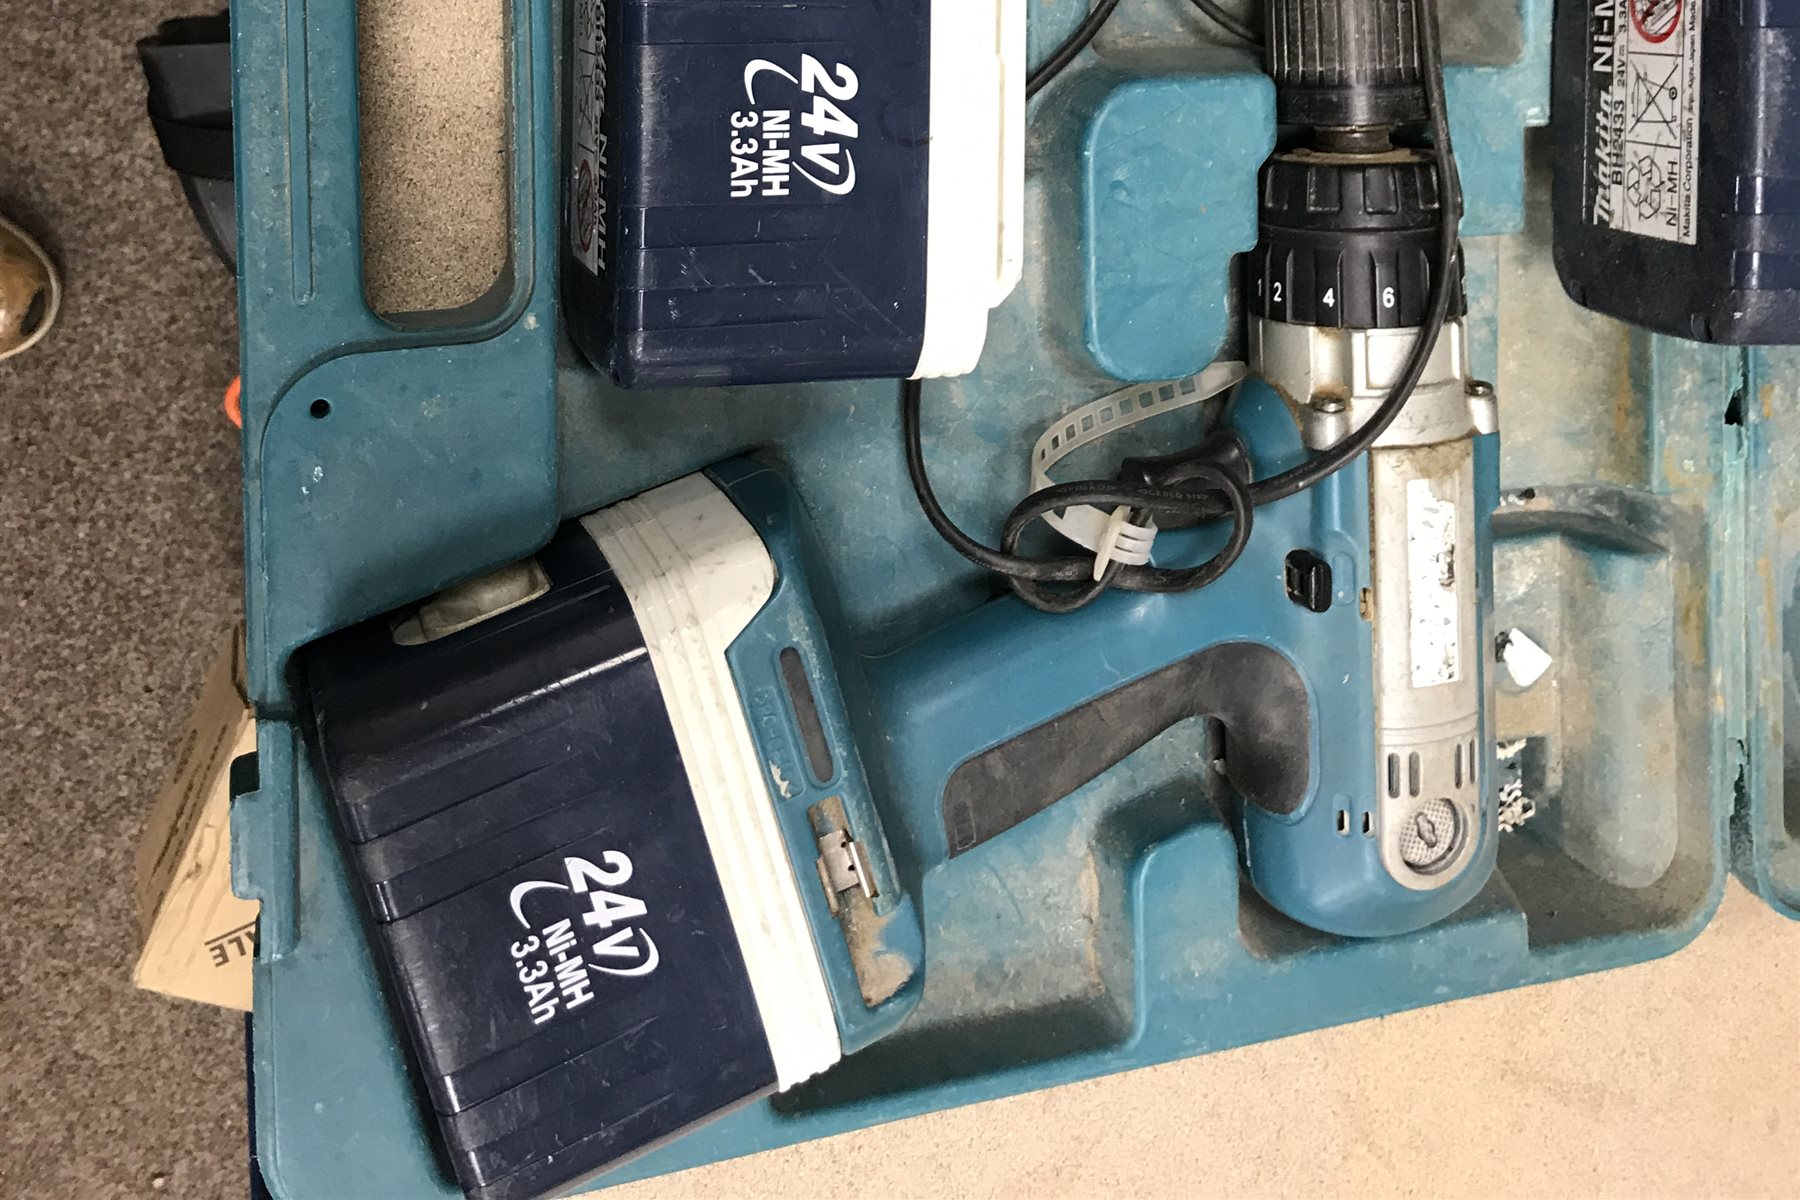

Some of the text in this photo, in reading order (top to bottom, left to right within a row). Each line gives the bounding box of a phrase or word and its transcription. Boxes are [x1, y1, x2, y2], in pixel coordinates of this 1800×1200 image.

[1688, 0, 1696, 31] Made
[730, 111, 758, 197] 3.3Ah
[762, 110, 790, 196] Ni-MH
[801, 53, 858, 175] 24V
[1612, 100, 1625, 186] BH2433
[1683, 117, 1694, 191] Corporation
[1666, 161, 1678, 226] Ni-MH
[1683, 195, 1691, 237] Makita
[1257, 278, 1395, 308] 1 2 4 6
[564, 850, 648, 957] 24V
[511, 935, 559, 1025] 3.3Ah
[542, 918, 594, 1010] Ni-MH
